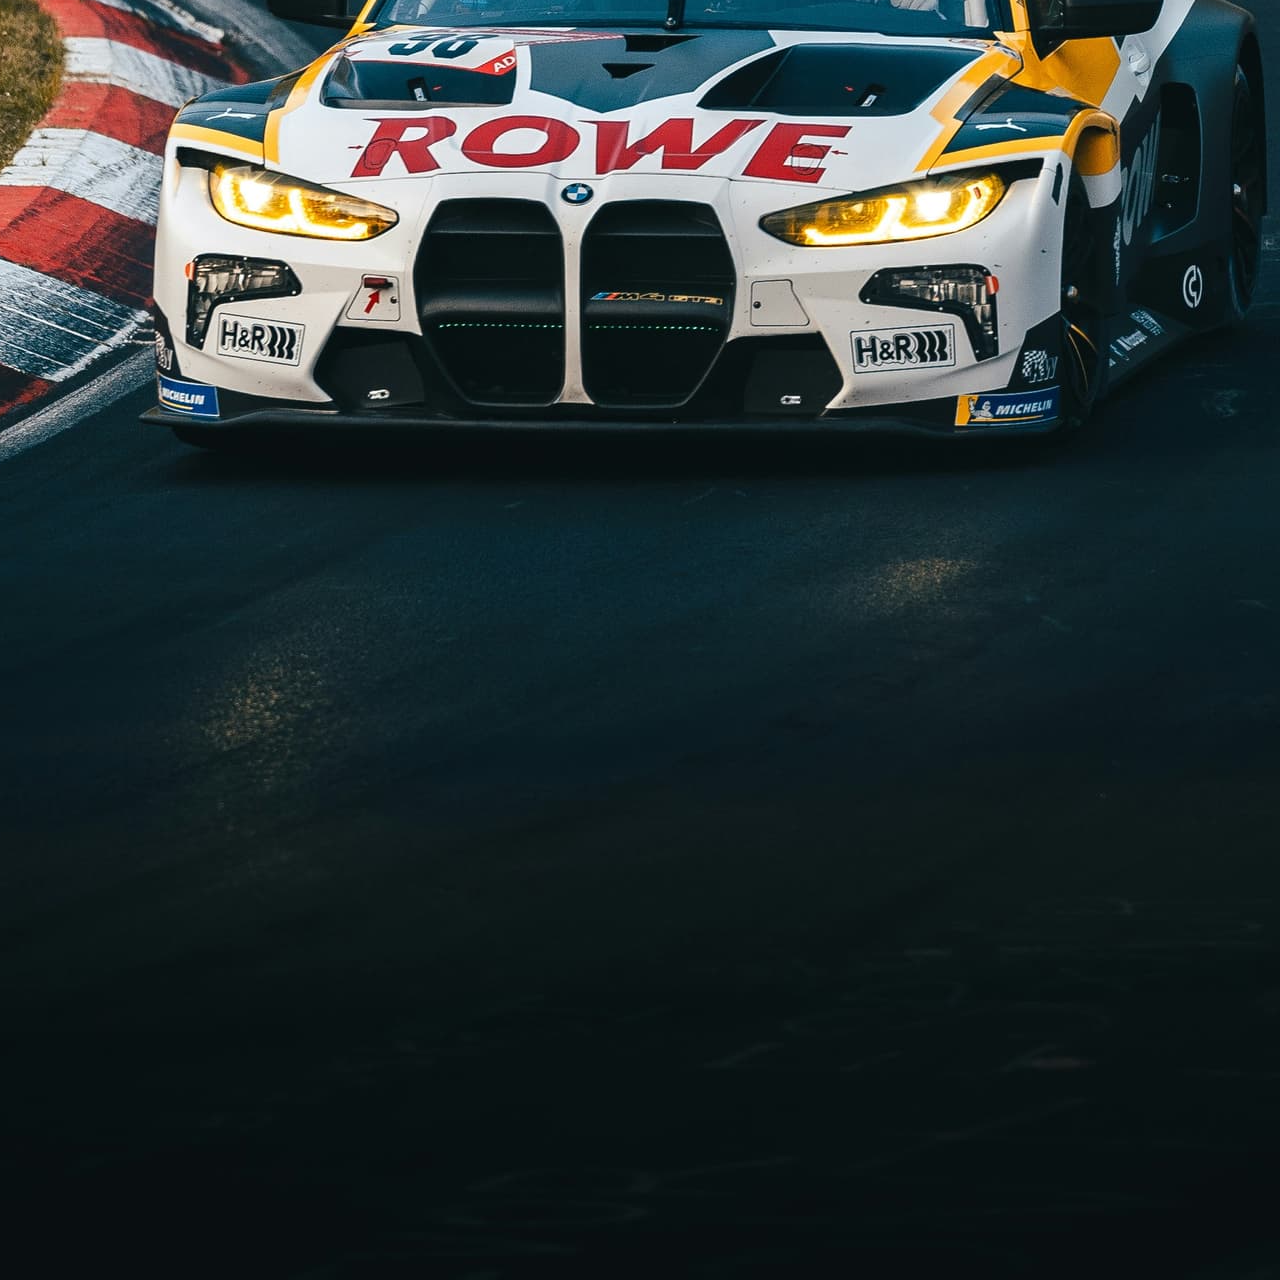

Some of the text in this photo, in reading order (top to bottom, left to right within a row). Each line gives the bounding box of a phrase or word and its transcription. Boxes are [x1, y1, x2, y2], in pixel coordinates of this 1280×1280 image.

[387, 33, 500, 59] 98
[493, 55, 516, 73] AD
[350, 115, 851, 184] ROWE
[221, 319, 268, 356] H&R
[854, 333, 919, 368] H&R
[162, 386, 206, 406] MICHELIN
[995, 399, 1053, 416] MICHELIN
